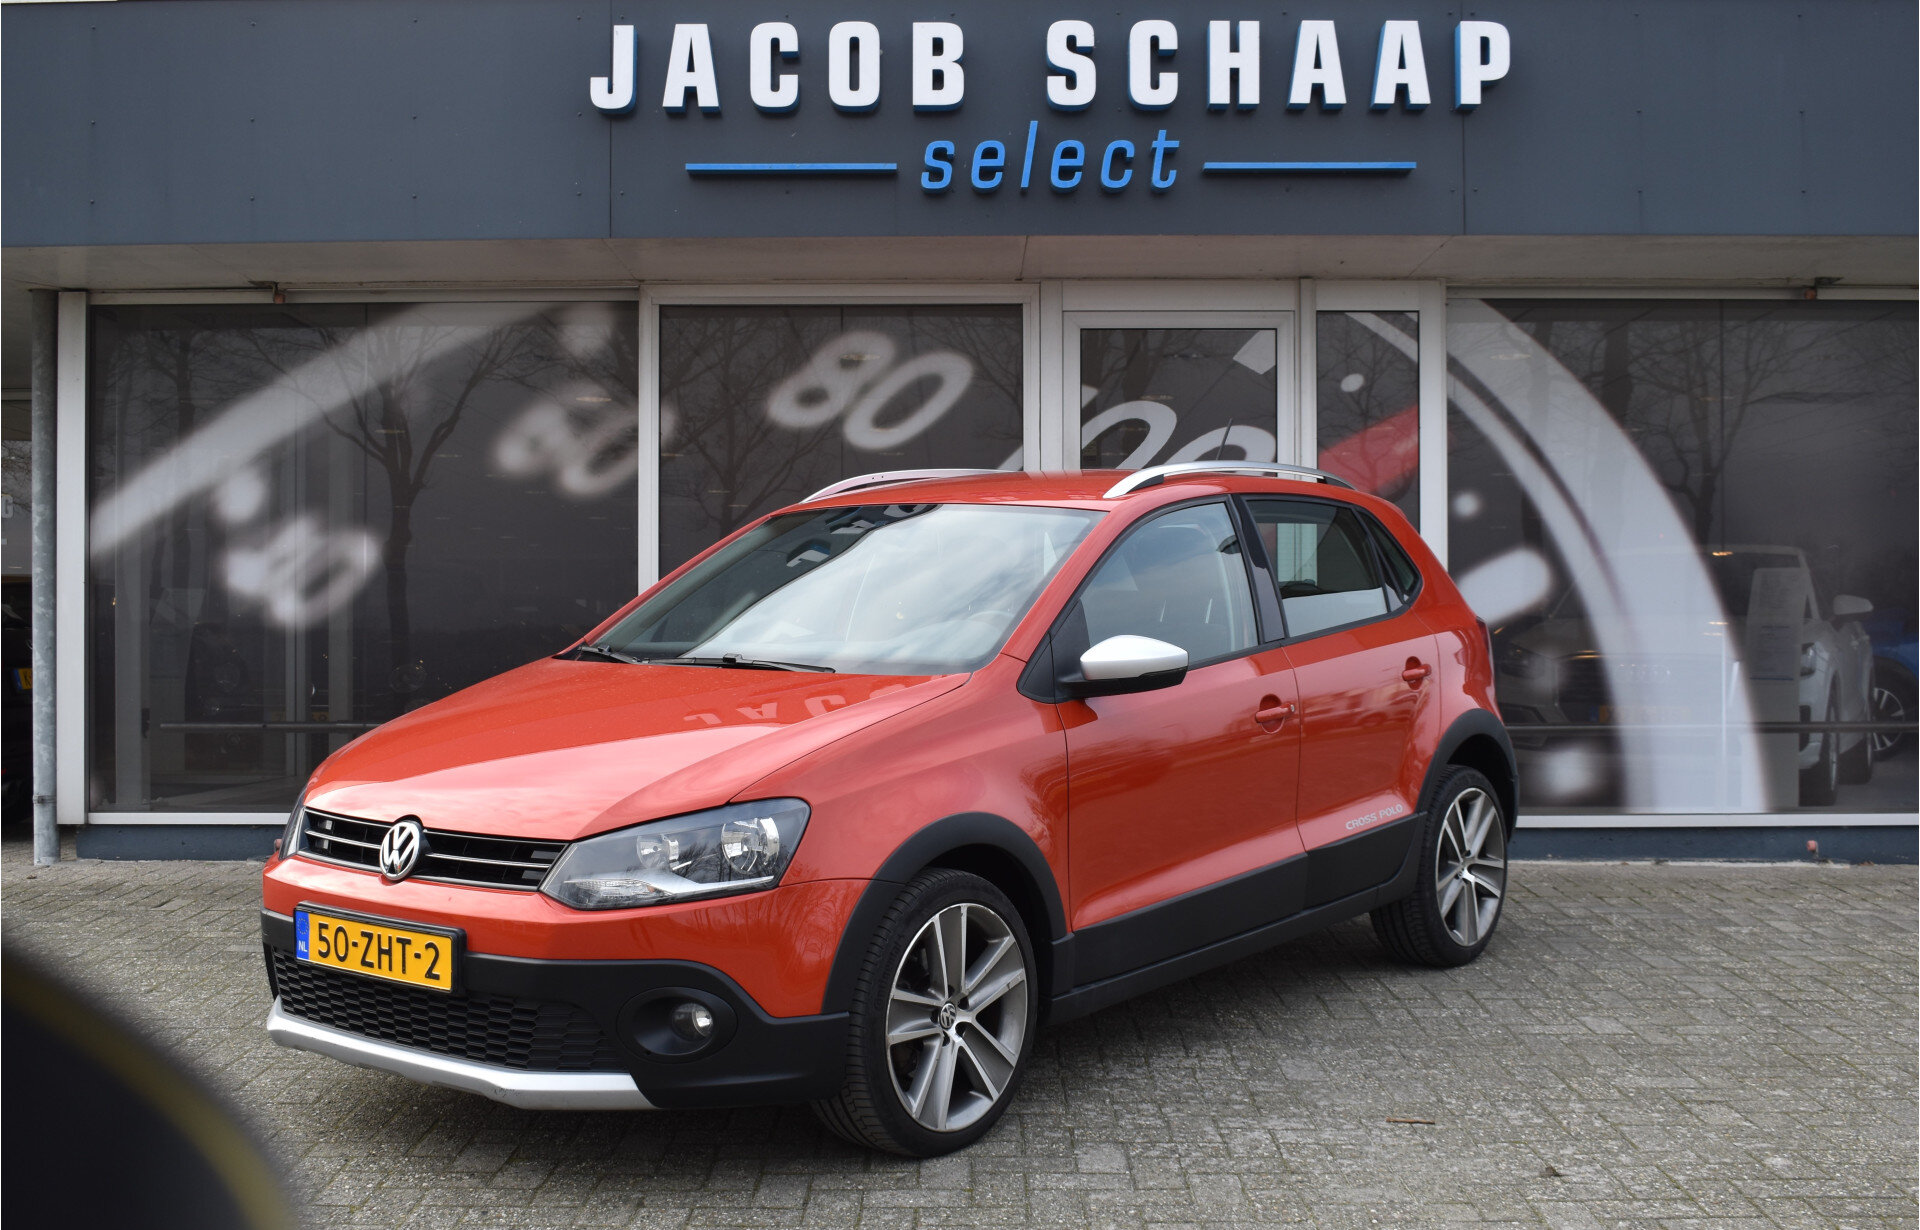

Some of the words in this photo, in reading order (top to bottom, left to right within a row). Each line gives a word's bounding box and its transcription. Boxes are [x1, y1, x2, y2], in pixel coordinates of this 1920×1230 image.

[590, 20, 966, 114] JACOB
[1046, 18, 1511, 113] SCHAAP
[919, 120, 1180, 194] select
[766, 330, 973, 452] 80
[1345, 812, 1378, 830] CROSS
[1378, 803, 1403, 820] POLO
[298, 940, 308, 953] NL
[317, 920, 441, 981] 50-ZHT-2
